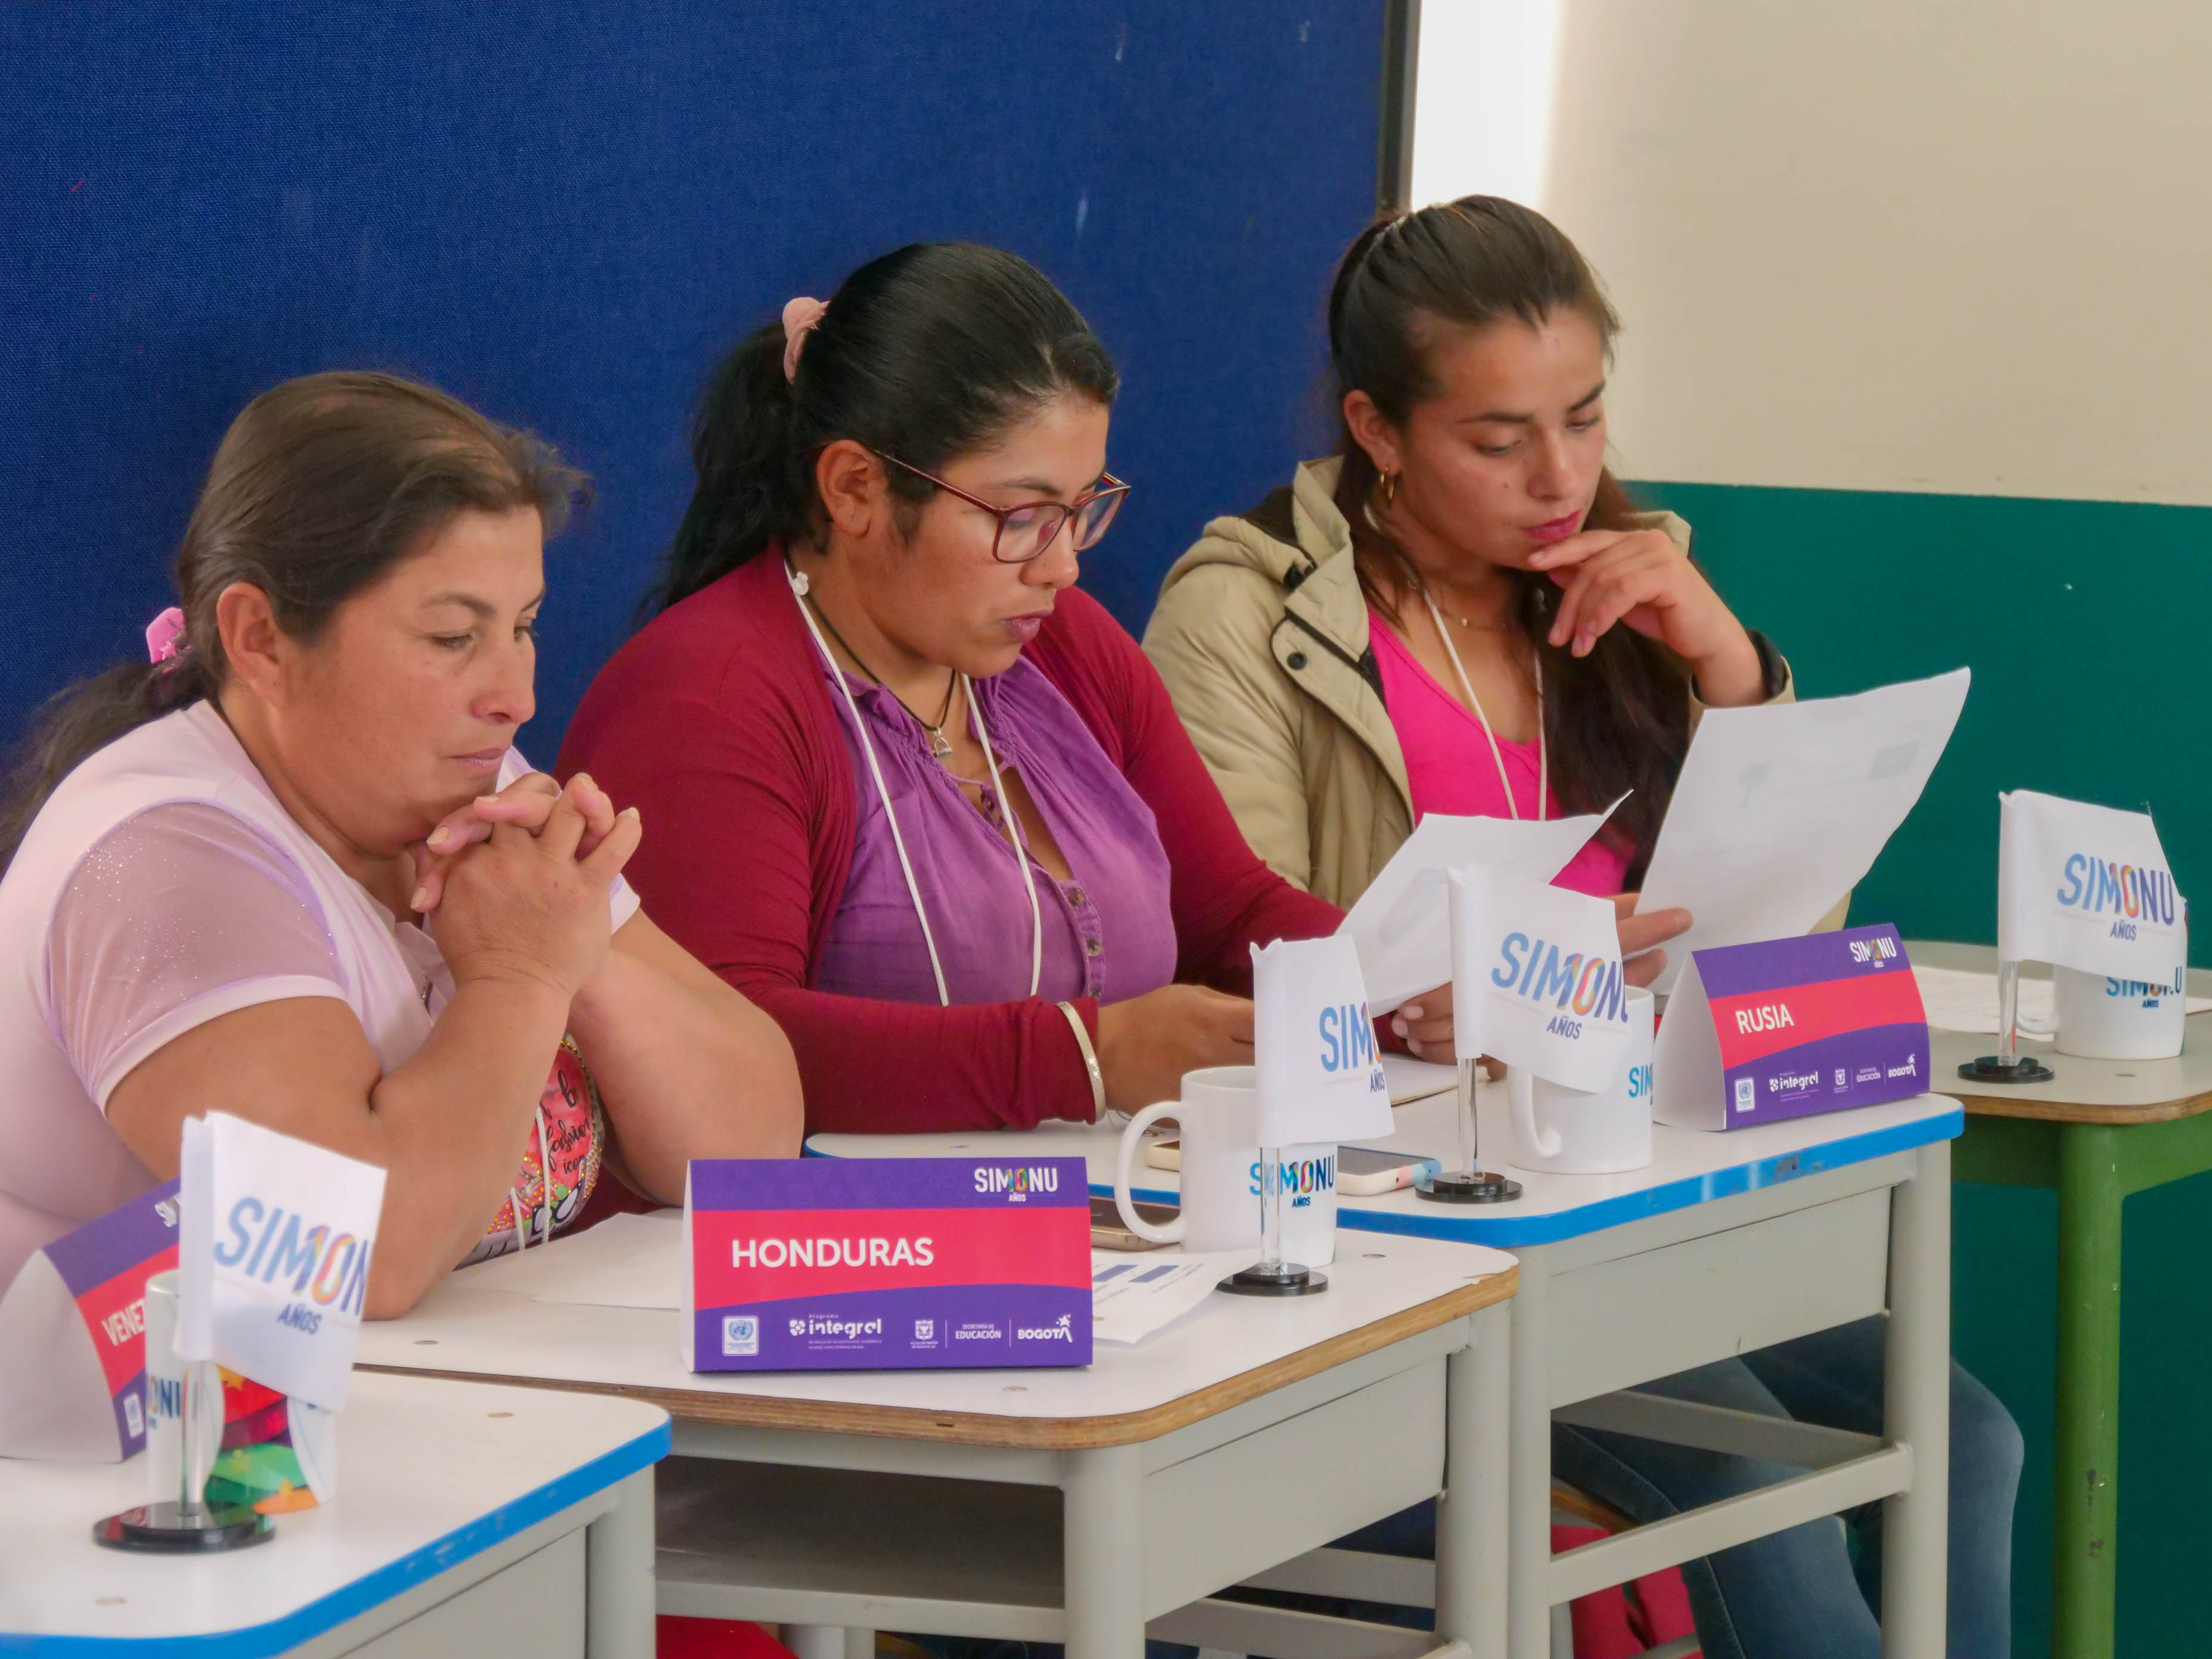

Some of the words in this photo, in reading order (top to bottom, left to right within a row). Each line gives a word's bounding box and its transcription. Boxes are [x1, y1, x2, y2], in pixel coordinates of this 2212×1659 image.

[2110, 919, 2137, 941] AÑOS
[1546, 1015, 1582, 1039] AÑOS
[1735, 1004, 1794, 1034] RUSIA
[1779, 1071, 1818, 1091] integral
[1249, 1155, 1334, 1195] SMONU
[1008, 1192, 1026, 1202] AÑOS
[1292, 1195, 1310, 1208] AÑOS
[732, 1238, 934, 1267] HONDURAS
[276, 1303, 322, 1335] AÑOS
[809, 1318, 882, 1339] integral
[956, 1329, 1001, 1339] EDUCACIÓN
